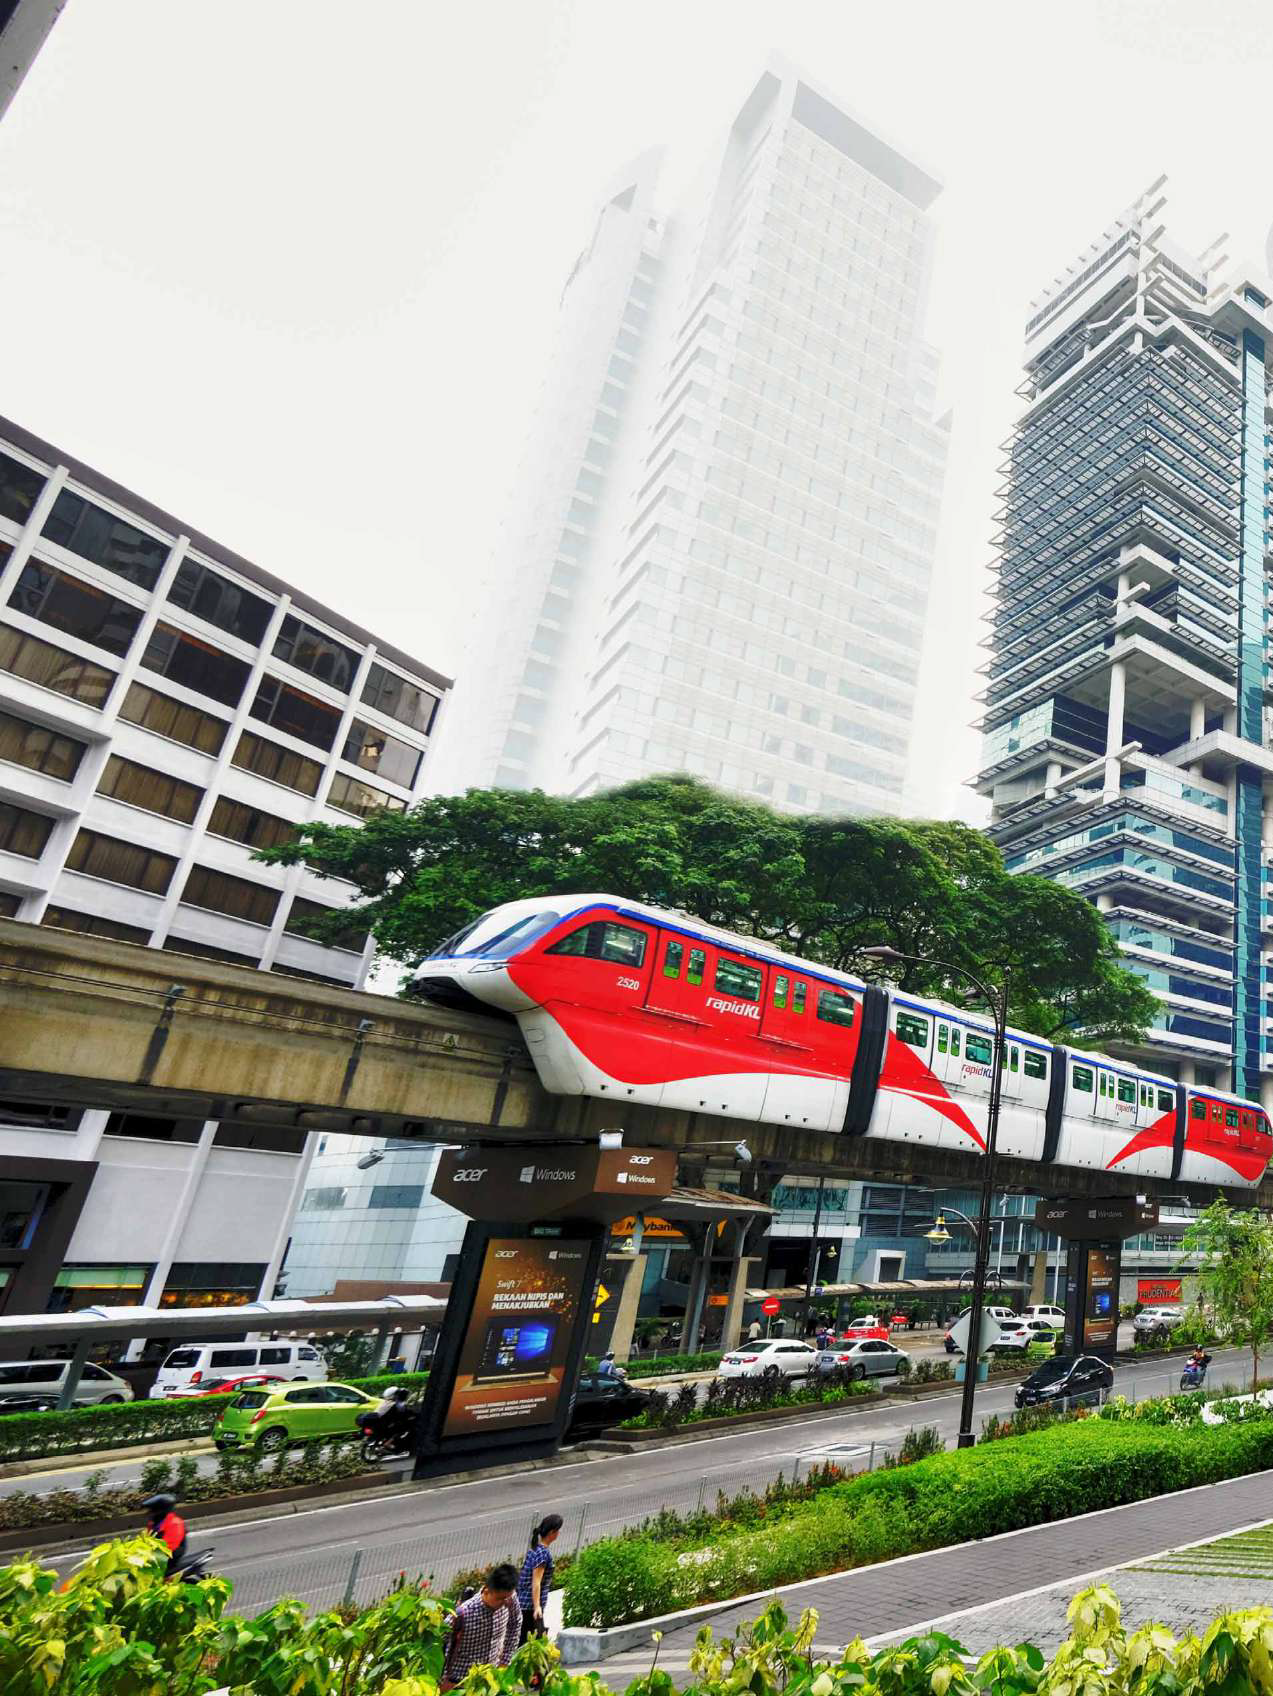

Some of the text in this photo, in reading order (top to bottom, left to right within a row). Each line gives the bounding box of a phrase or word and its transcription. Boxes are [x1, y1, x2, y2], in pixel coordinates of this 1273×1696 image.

[616, 976, 640, 991] 2520
[706, 996, 760, 1020] rapidKL
[961, 1063, 993, 1079] rapidKL
[1115, 1102, 1137, 1115] rapidKL
[629, 1154, 655, 1165] acer
[453, 1168, 488, 1182] acer
[536, 1167, 576, 1182] Windows
[628, 1173, 656, 1184] Windows
[1046, 1210, 1068, 1219] acer
[625, 1221, 673, 1232] Myban
[495, 1250, 519, 1258] acer
[493, 1293, 526, 1301] REKAAN
[548, 1292, 565, 1300] DAN
